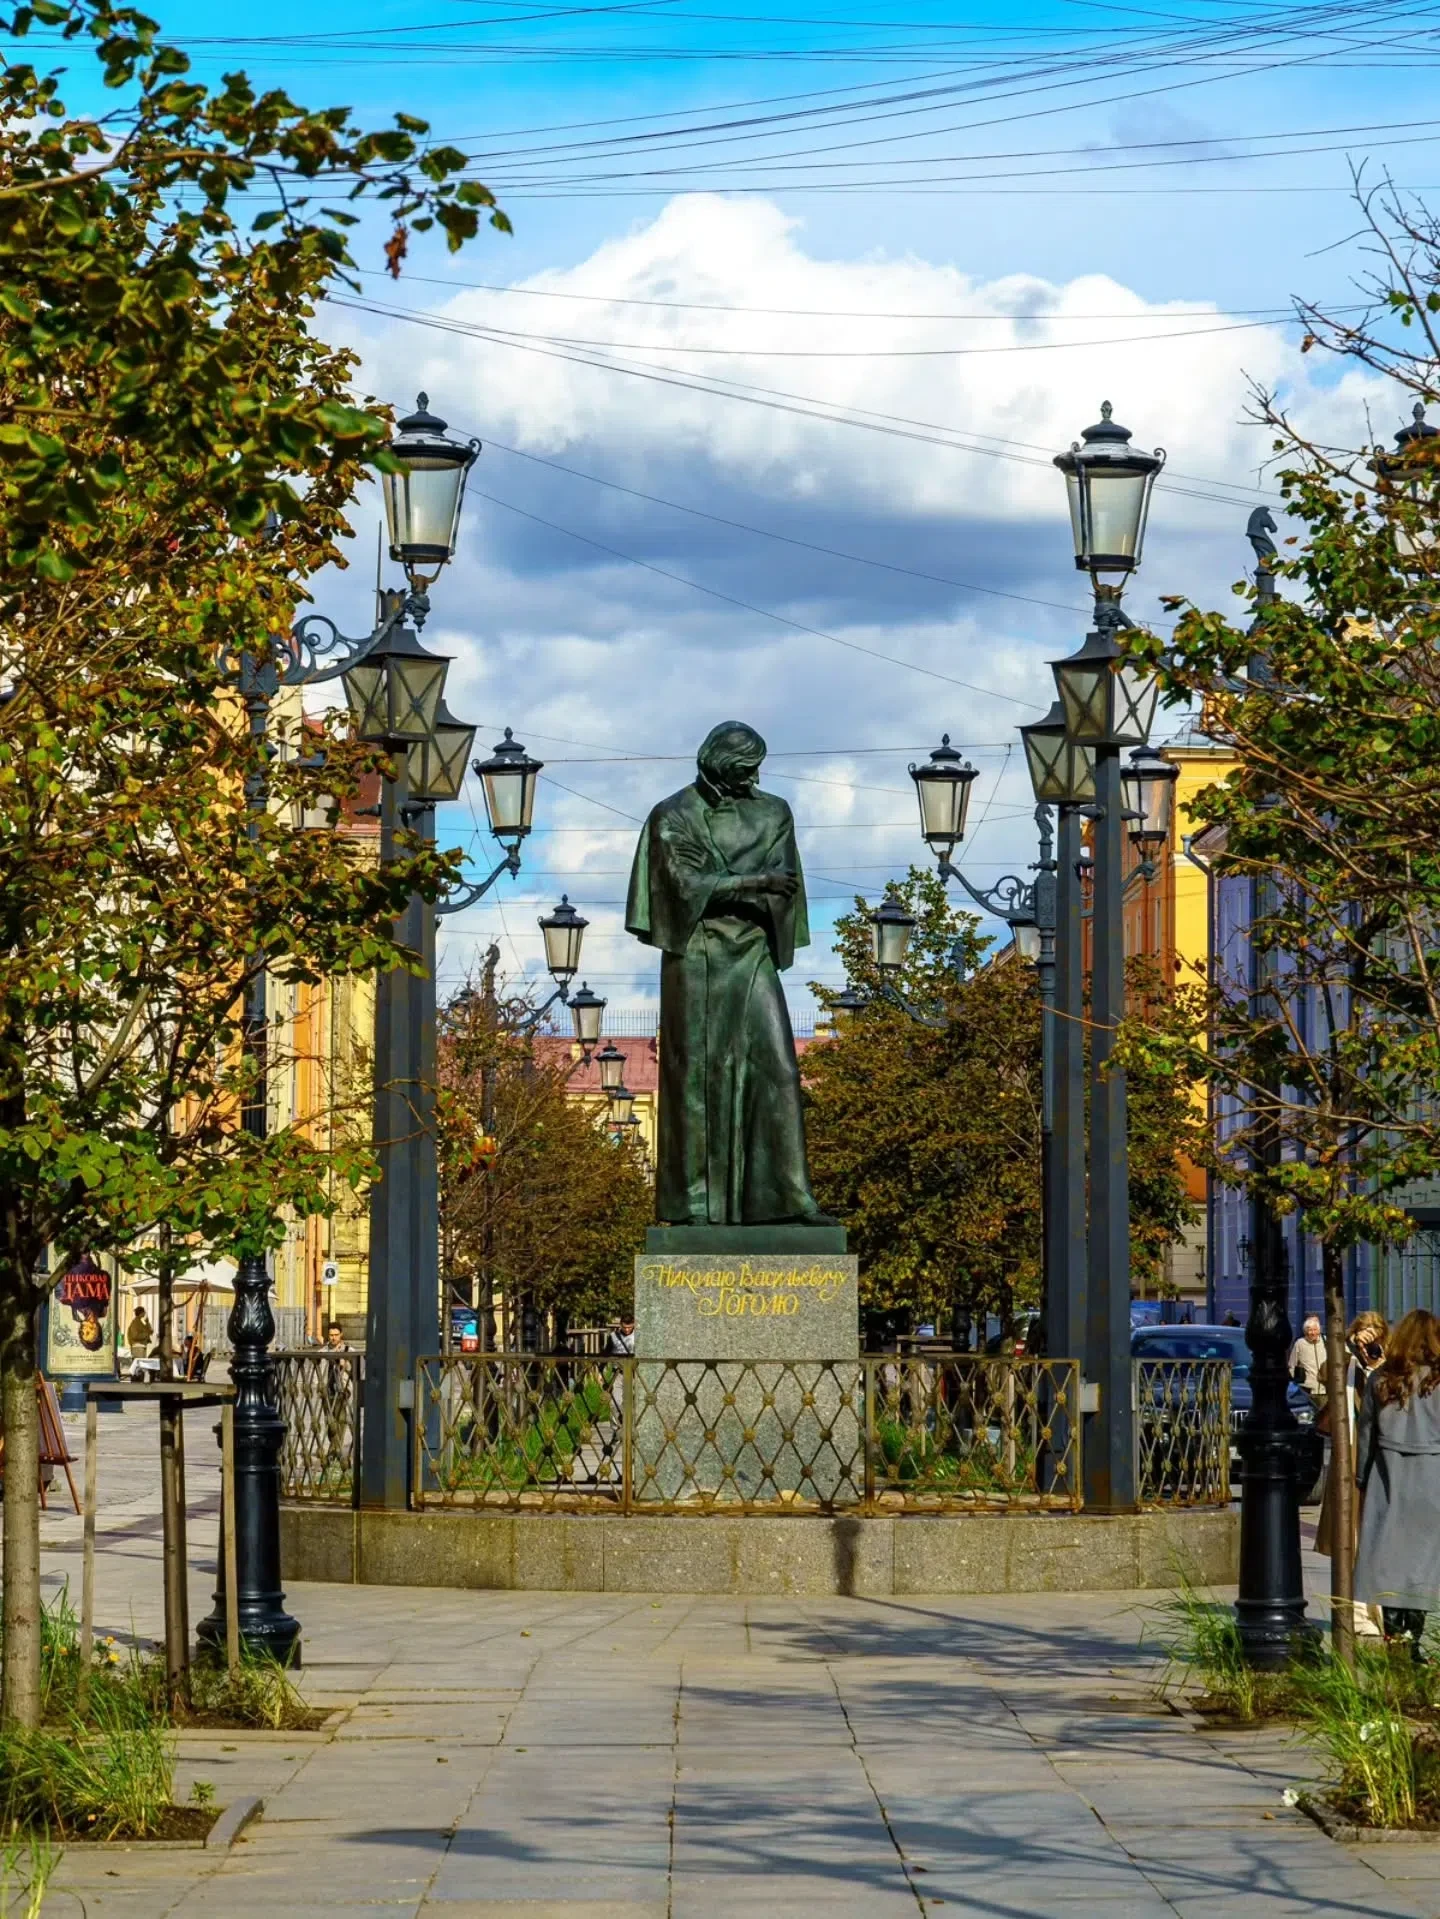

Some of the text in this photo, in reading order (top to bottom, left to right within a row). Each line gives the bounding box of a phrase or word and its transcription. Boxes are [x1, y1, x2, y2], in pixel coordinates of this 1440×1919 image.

[64, 1282, 110, 1300] ДАМА
[641, 1264, 847, 1301] Николаю Васильевичу
